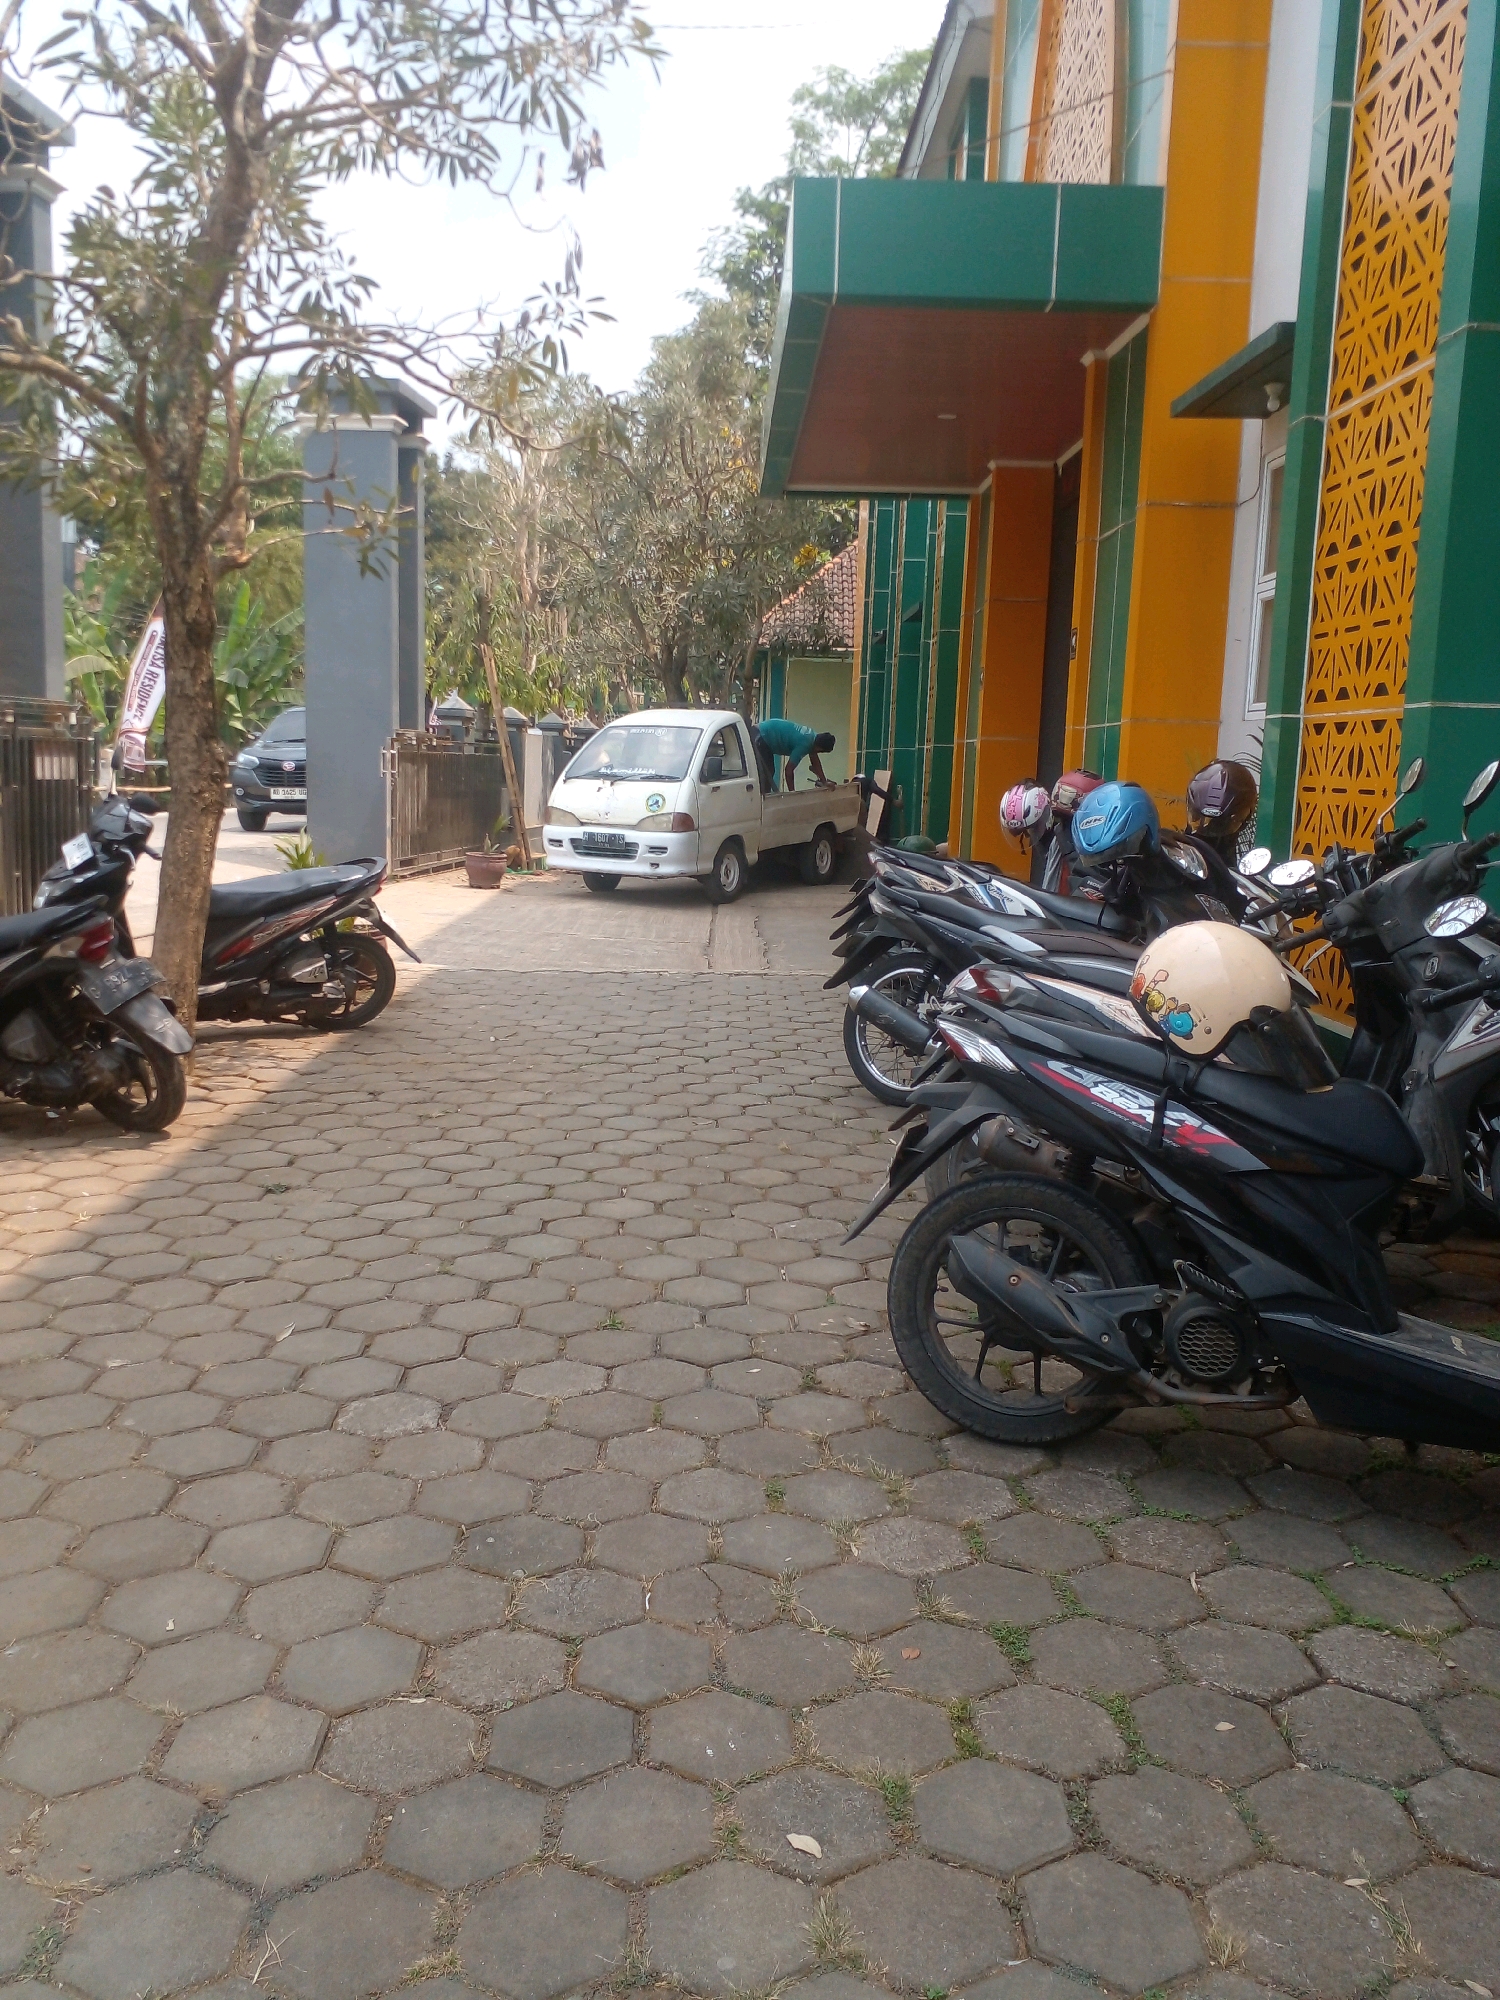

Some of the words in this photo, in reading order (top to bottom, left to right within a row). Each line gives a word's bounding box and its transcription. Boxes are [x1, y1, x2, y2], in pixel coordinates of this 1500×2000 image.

[132, 671, 161, 723] RESIDENCE
[281, 788, 297, 796] 1625
[1081, 816, 1104, 828] INK
[582, 832, 589, 842] H
[594, 833, 609, 843] 1607
